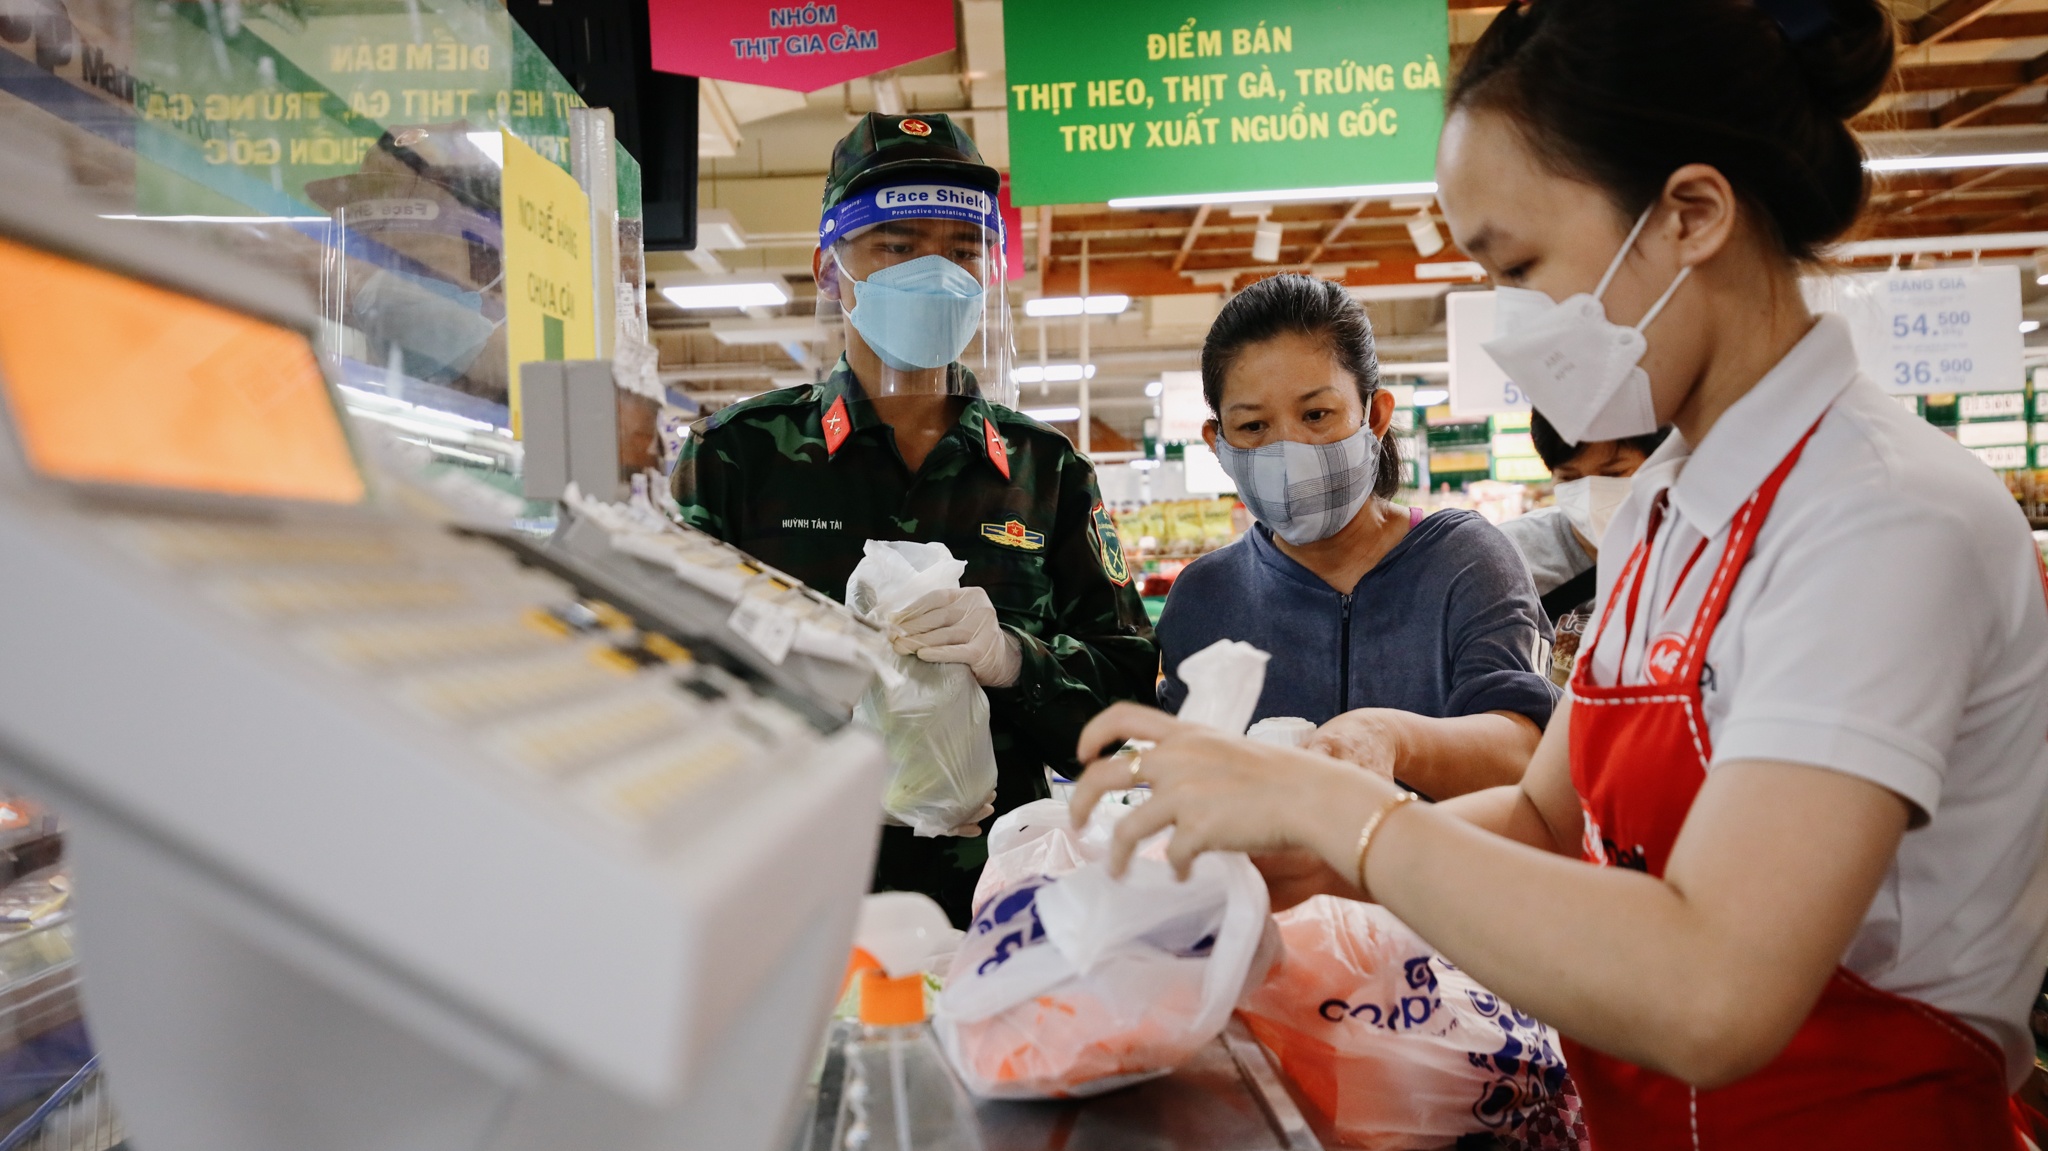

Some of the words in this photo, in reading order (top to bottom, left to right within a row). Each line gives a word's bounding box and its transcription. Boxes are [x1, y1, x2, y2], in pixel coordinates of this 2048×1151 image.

[770, 2, 837, 28] NHÓM
[731, 36, 781, 62] THỊT
[785, 34, 825, 55] GIA
[828, 25, 878, 51] CẦM
[1147, 17, 1222, 60] ĐIỂM
[1232, 20, 1292, 55] BÁN
[1011, 82, 1077, 116] THỊT
[1087, 78, 1154, 110] HEO,
[1162, 74, 1228, 107] THỊT
[1238, 64, 1286, 102] GÀ,
[1294, 58, 1394, 96] TRỨNG
[1402, 53, 1441, 90] GÀ
[1059, 122, 1135, 152] TRUY
[1145, 107, 1220, 148] XUẤT
[1231, 101, 1329, 144] NGUỒN
[1338, 98, 1398, 138] GỐC
[885, 190, 928, 204] Face
[936, 188, 988, 210] Shield
[892, 208, 931, 216] Protective
[934, 208, 966, 218] Isolation
